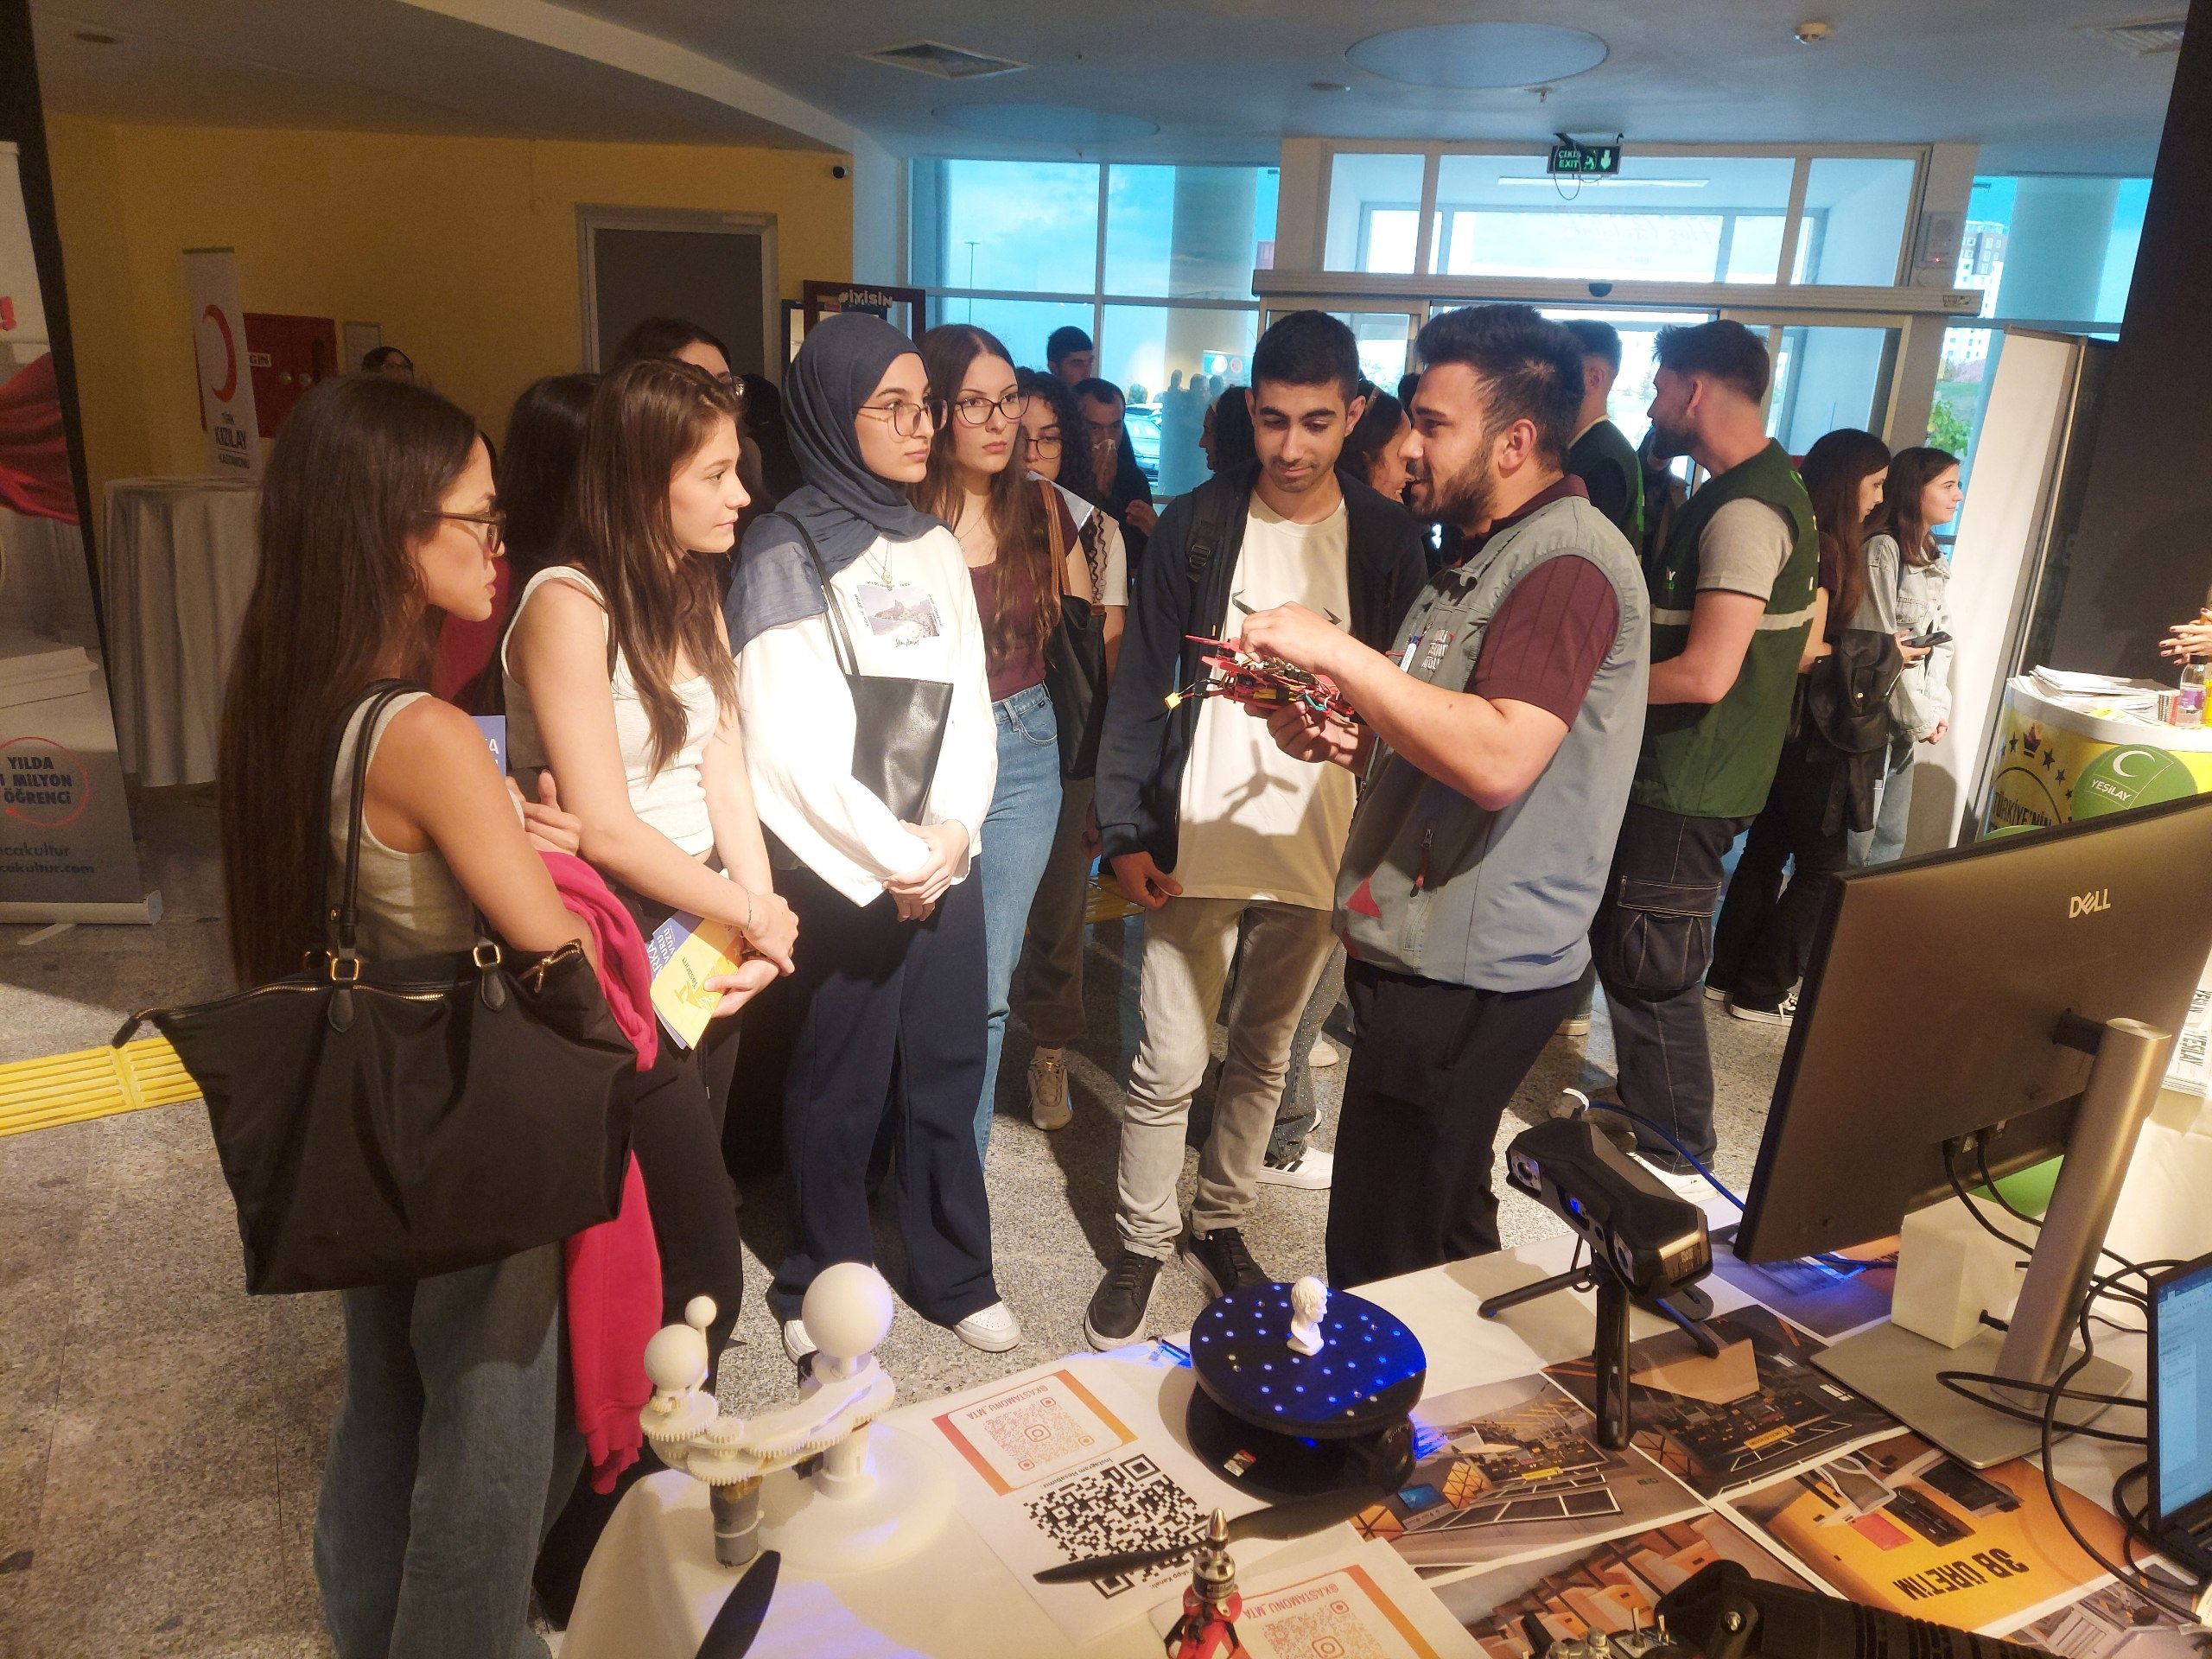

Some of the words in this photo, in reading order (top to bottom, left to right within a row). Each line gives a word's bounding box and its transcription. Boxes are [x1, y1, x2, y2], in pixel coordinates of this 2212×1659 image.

[1559, 159, 1580, 168] EXIT
[7, 756, 54, 769] YILDA
[13, 773, 73, 787] MİLYON
[2091, 779, 2132, 802] YEŞİLAY
[3, 787, 72, 804] ÖĞRENCİ
[2069, 888, 2111, 918] DELL
[682, 957, 699, 990] Tasarım
[965, 1384, 1049, 1420] @KASTAMONU_MTA
[1972, 1548, 2030, 1579] 3B
[1242, 1583, 1340, 1620] @KASTAMONU_MTA
